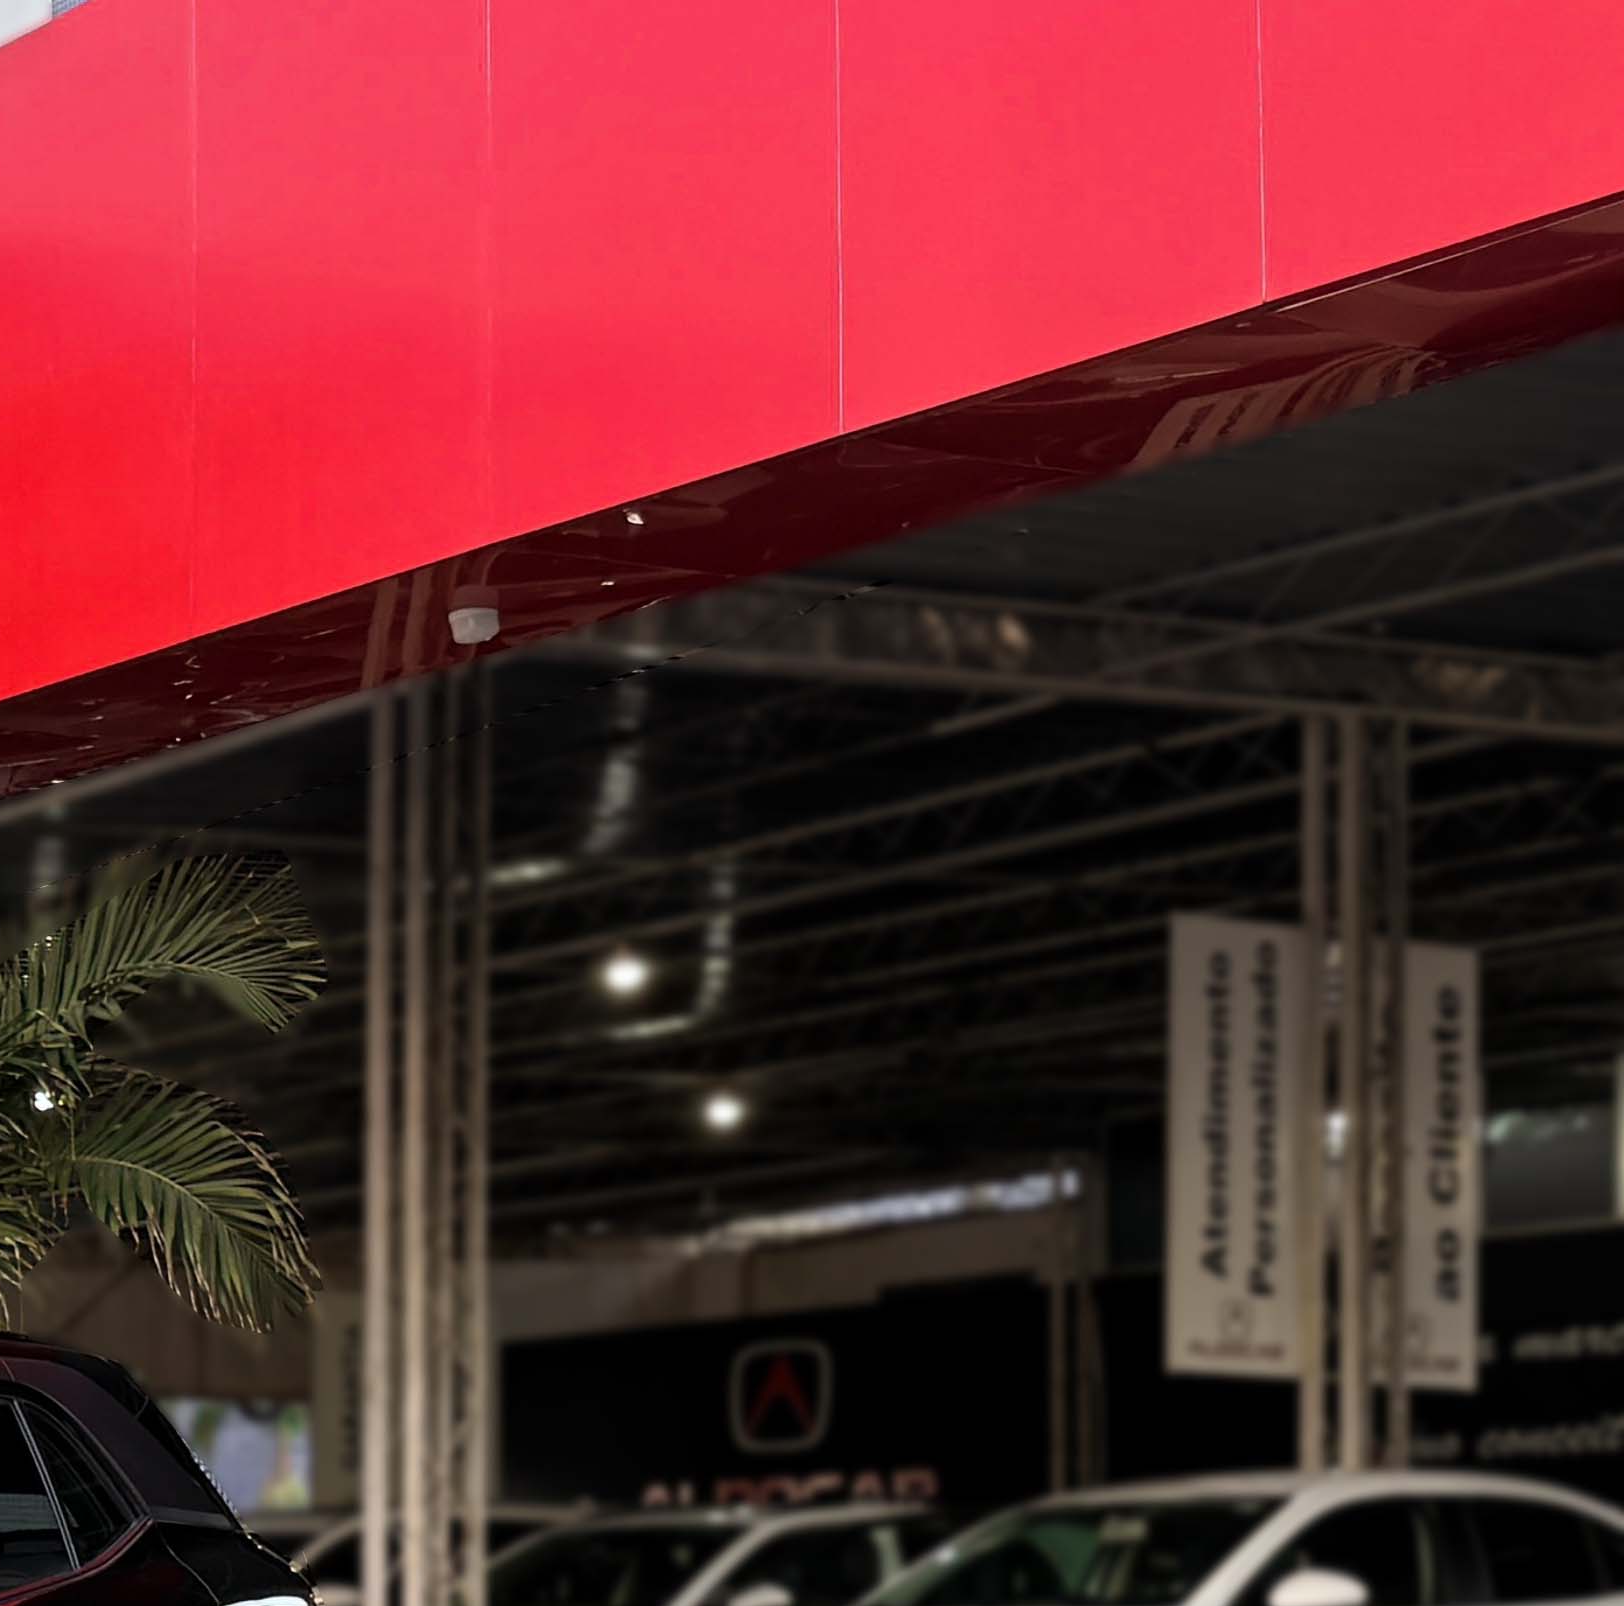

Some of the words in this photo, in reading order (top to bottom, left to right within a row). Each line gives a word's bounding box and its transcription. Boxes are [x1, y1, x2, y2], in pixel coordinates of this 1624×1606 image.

[1201, 950, 1232, 1280] Atendimento
[1248, 939, 1278, 1297] Personalizado
[1428, 986, 1464, 1203] Cliente
[1432, 1229, 1464, 1302] ao
